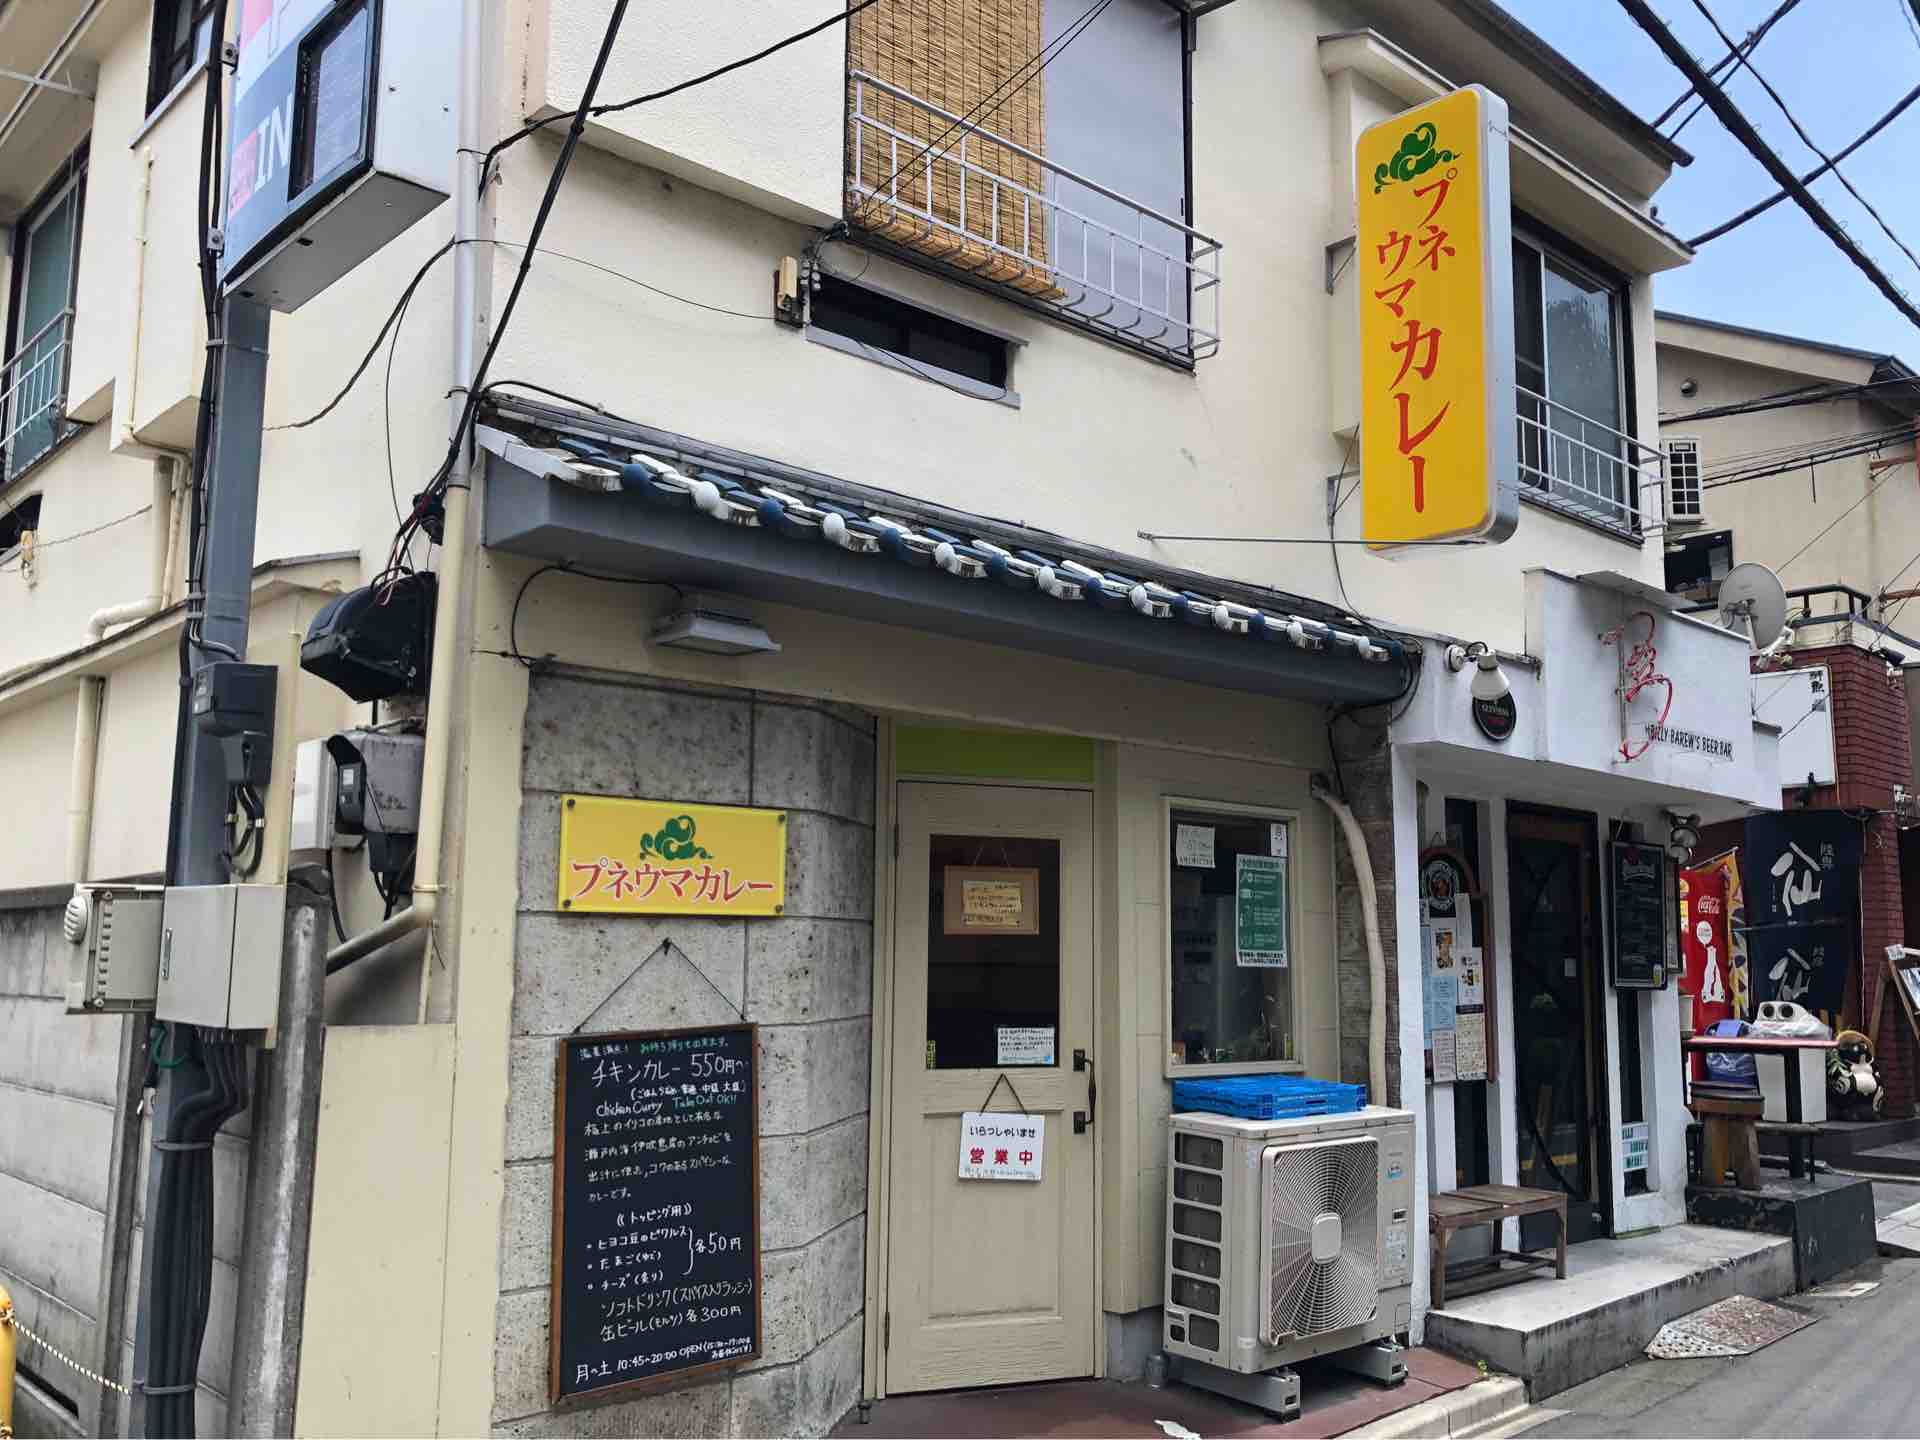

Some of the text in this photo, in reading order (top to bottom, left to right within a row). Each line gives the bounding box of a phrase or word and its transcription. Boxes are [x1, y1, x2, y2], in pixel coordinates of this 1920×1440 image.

[1702, 736, 1719, 754] BEER
[1720, 740, 1734, 758] BAR
[572, 856, 774, 903] プネウマカレー
[591, 1058, 682, 1088] チキンカレー
[633, 1099, 665, 1116] Curry
[969, 1146, 1034, 1166] 営業中
